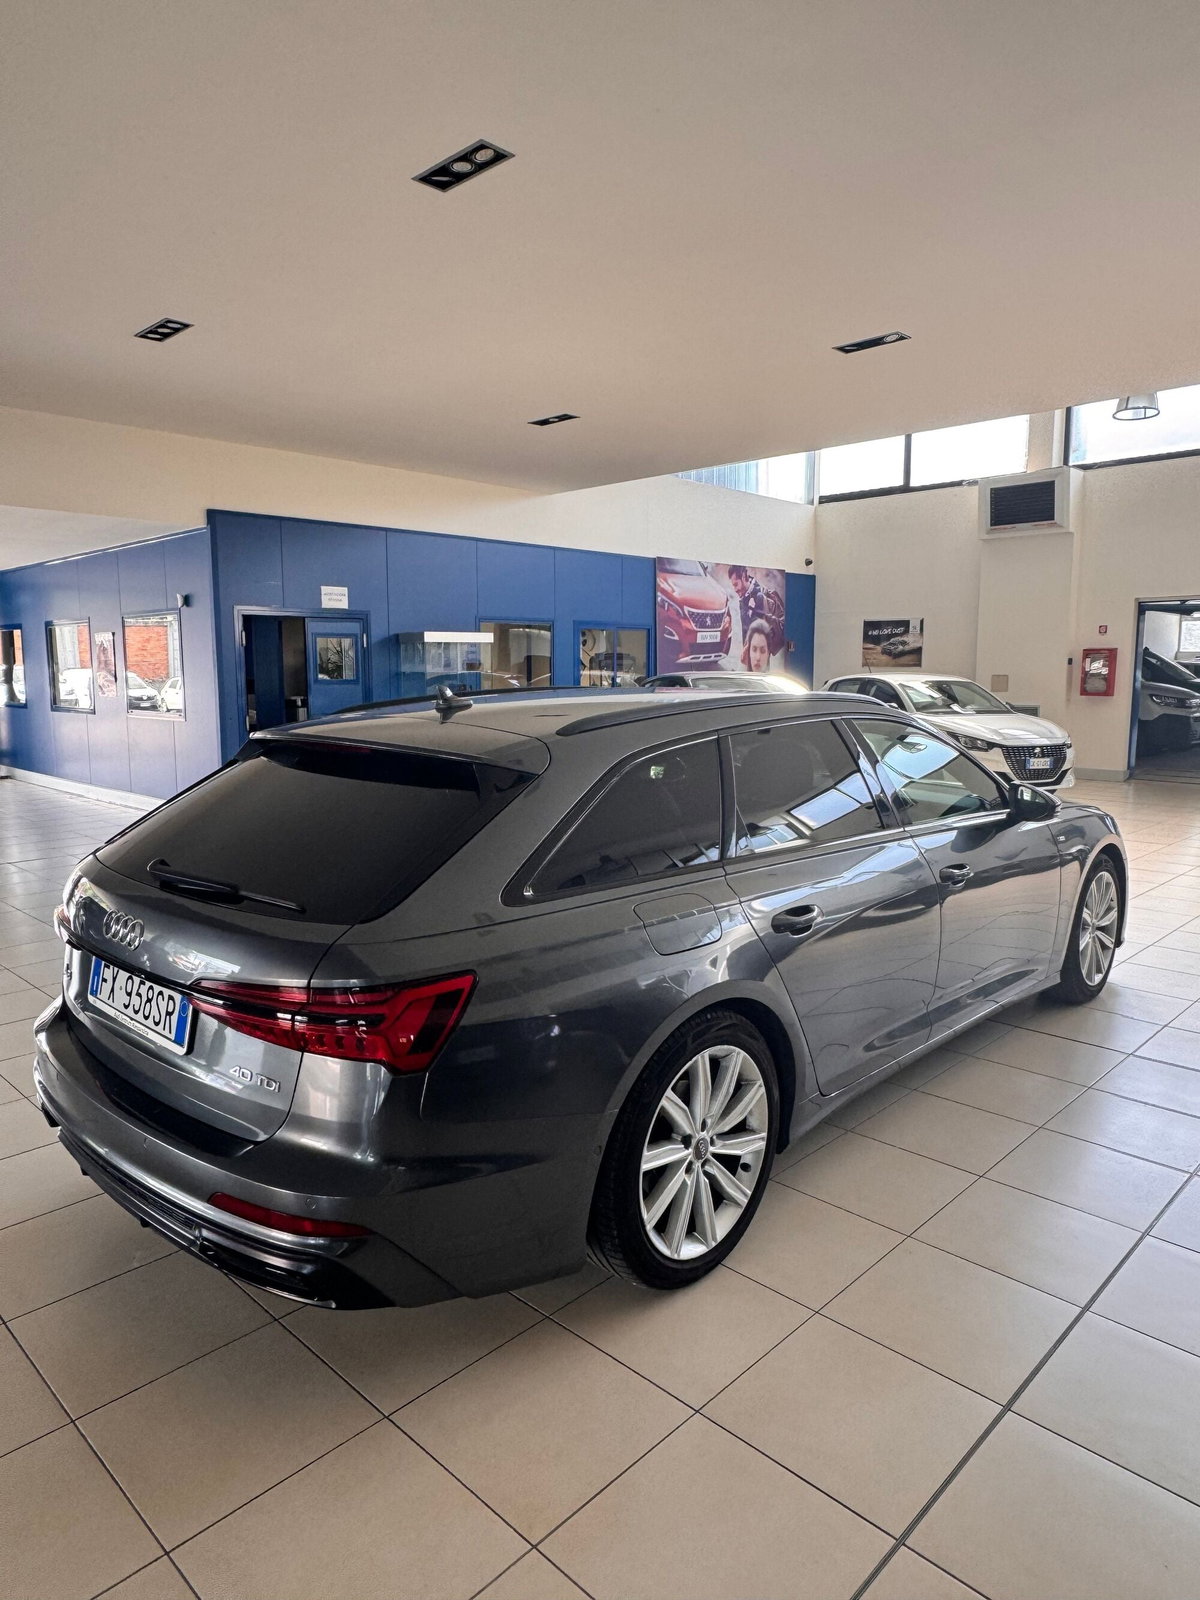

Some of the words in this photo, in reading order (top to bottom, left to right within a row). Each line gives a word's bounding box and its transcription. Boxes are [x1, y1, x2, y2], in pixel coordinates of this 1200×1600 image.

[99, 962, 120, 1004] FX
[122, 974, 176, 1035] 958SR
[229, 1065, 253, 1082] 40
[255, 1073, 281, 1093] TDI
